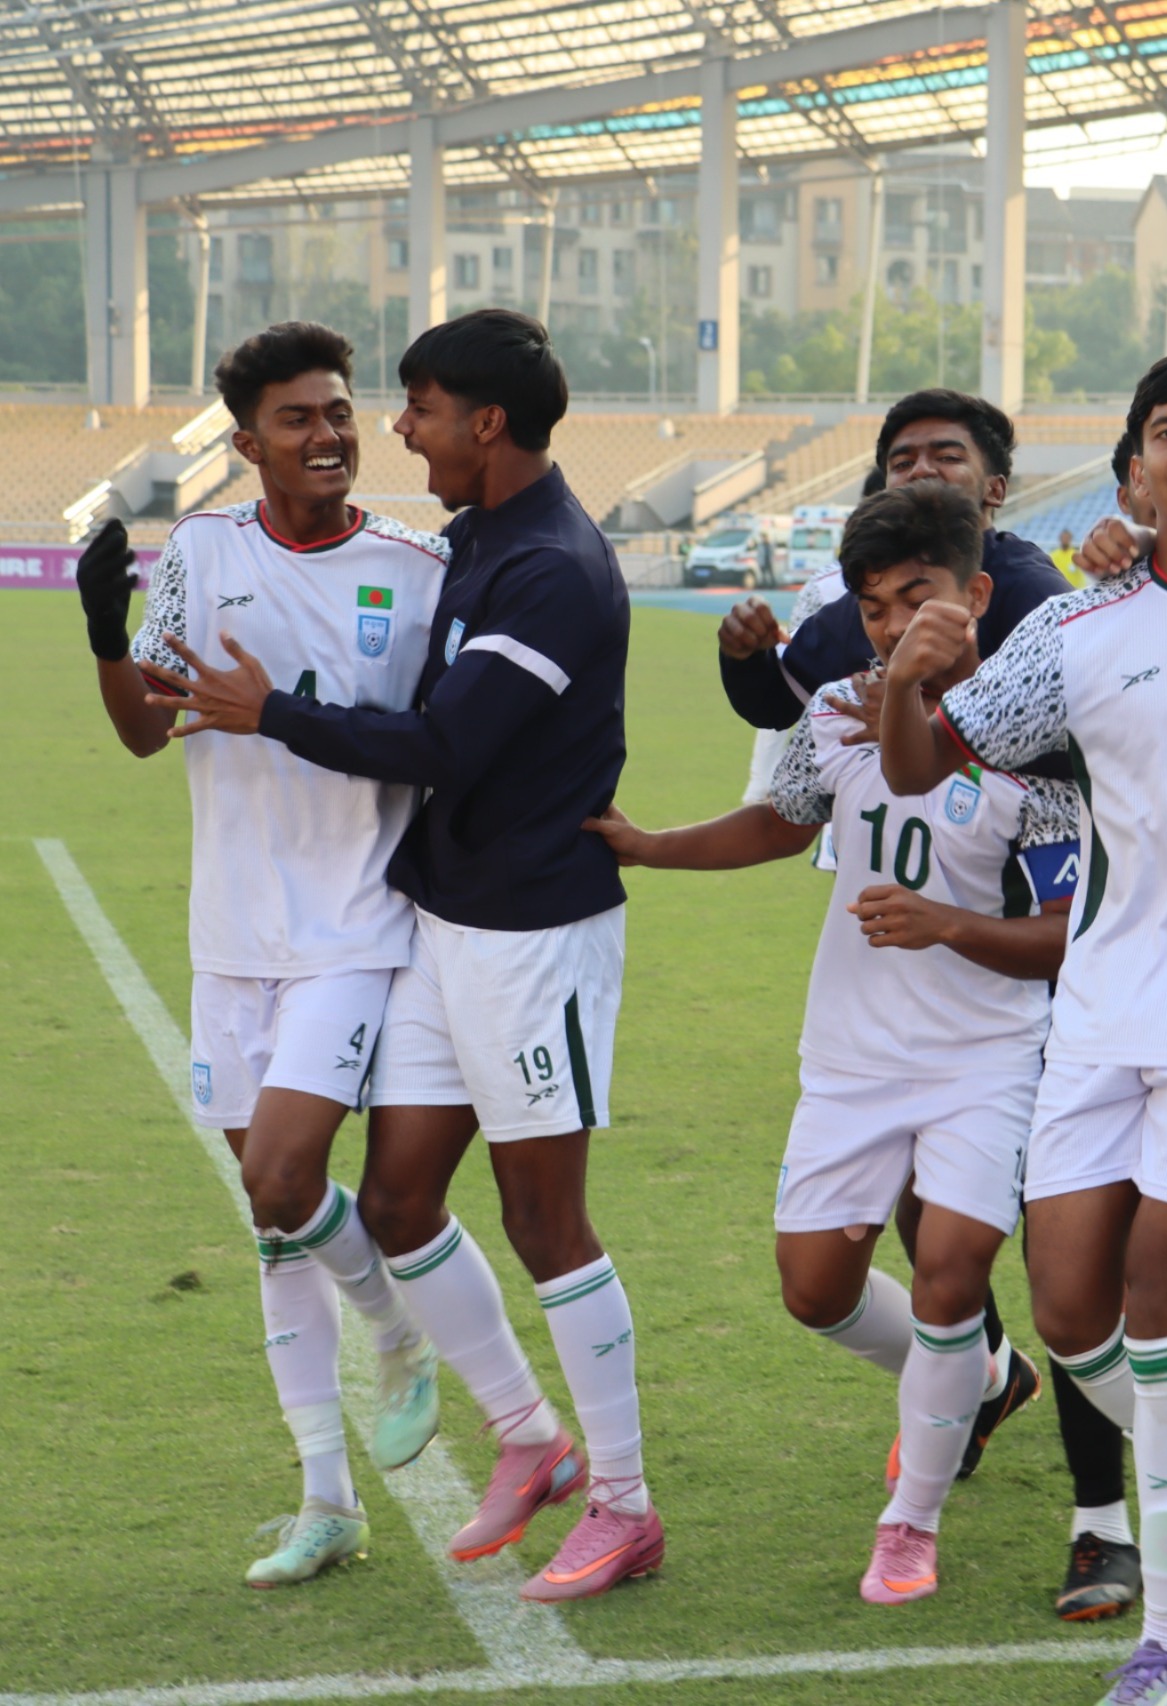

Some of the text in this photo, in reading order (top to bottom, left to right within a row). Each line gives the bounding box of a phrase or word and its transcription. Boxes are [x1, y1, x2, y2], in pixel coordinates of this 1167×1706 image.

[860, 802, 932, 891] 10
[349, 1022, 366, 1056] 4
[513, 1045, 554, 1085] 19
